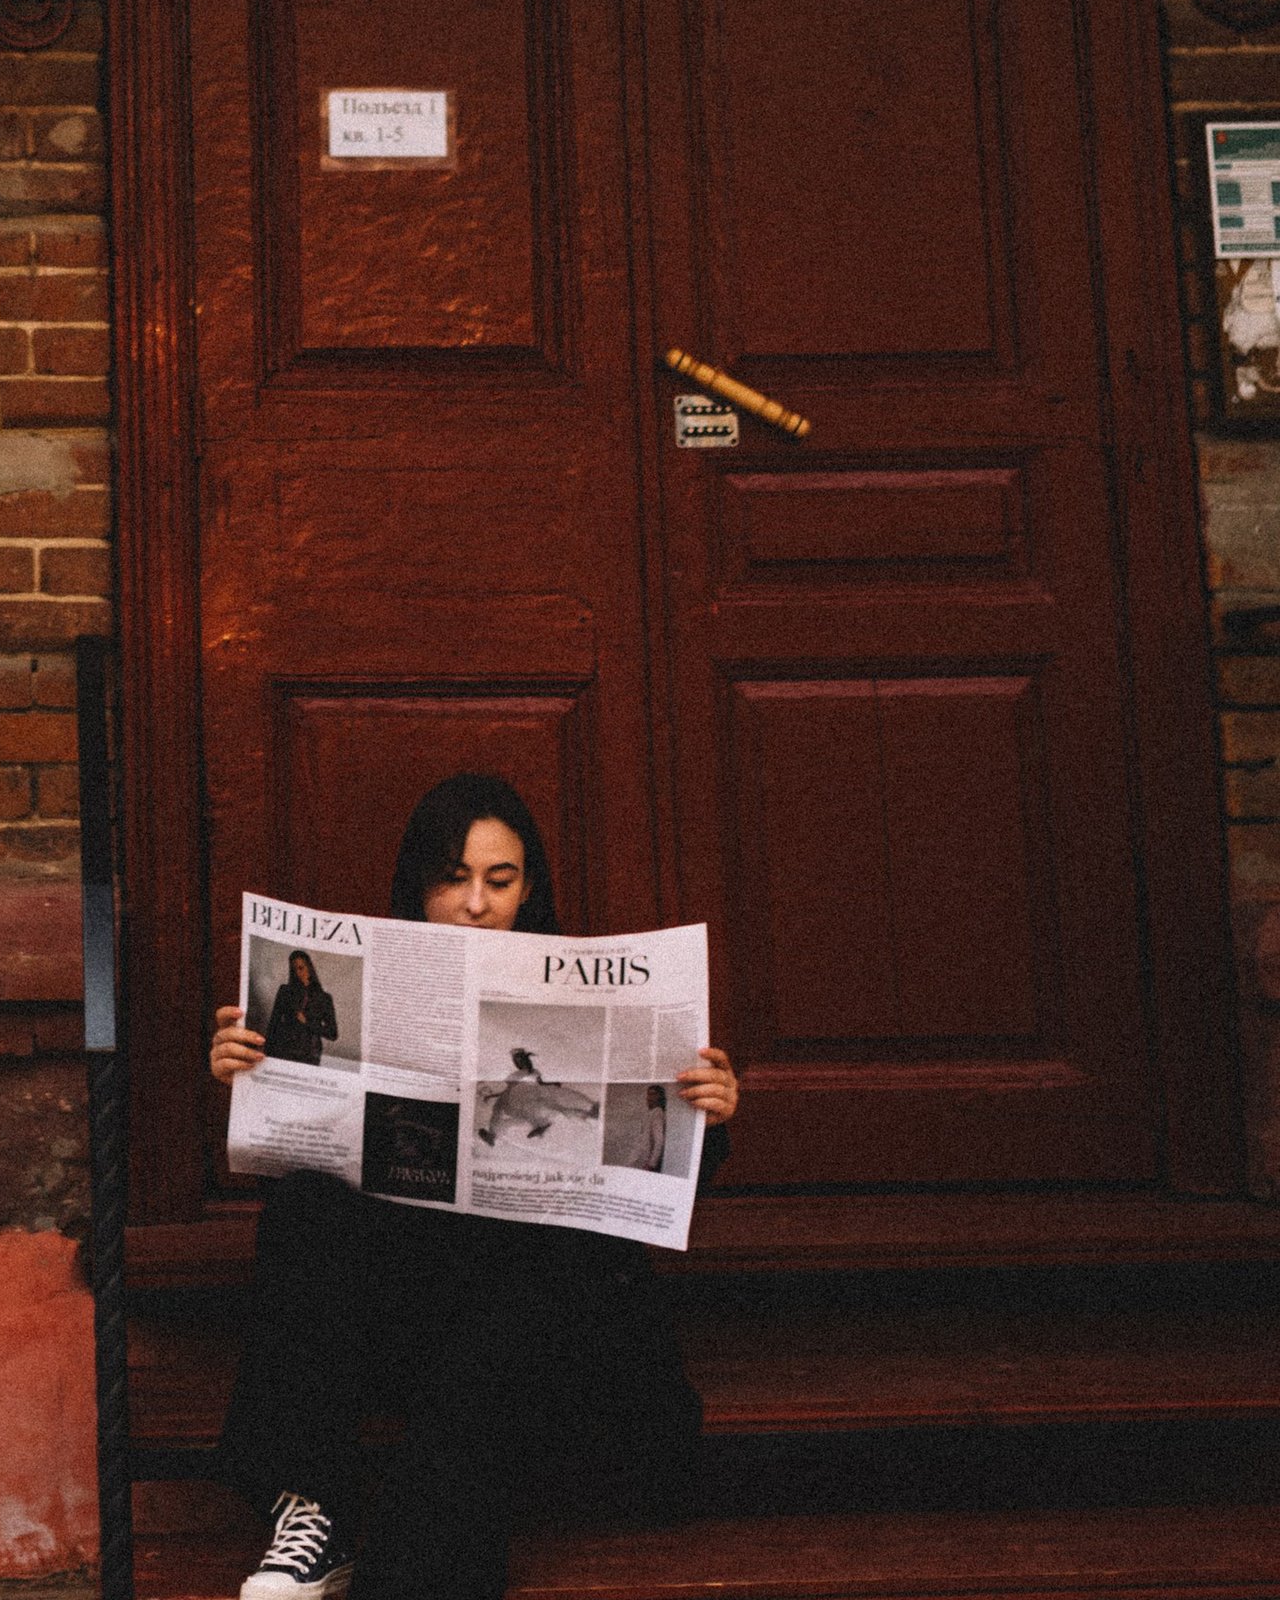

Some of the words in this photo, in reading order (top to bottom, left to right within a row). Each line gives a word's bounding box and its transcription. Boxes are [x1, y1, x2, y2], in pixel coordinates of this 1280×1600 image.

[429, 98, 436, 115] 1
[376, 125, 403, 142] 1-5
[251, 901, 362, 946] BELLEZA
[542, 954, 651, 987] PARIS
[471, 1168, 540, 1184] najprościej
[543, 1171, 564, 1184] jak
[568, 1171, 585, 1187] się
[588, 1173, 605, 1186] da
